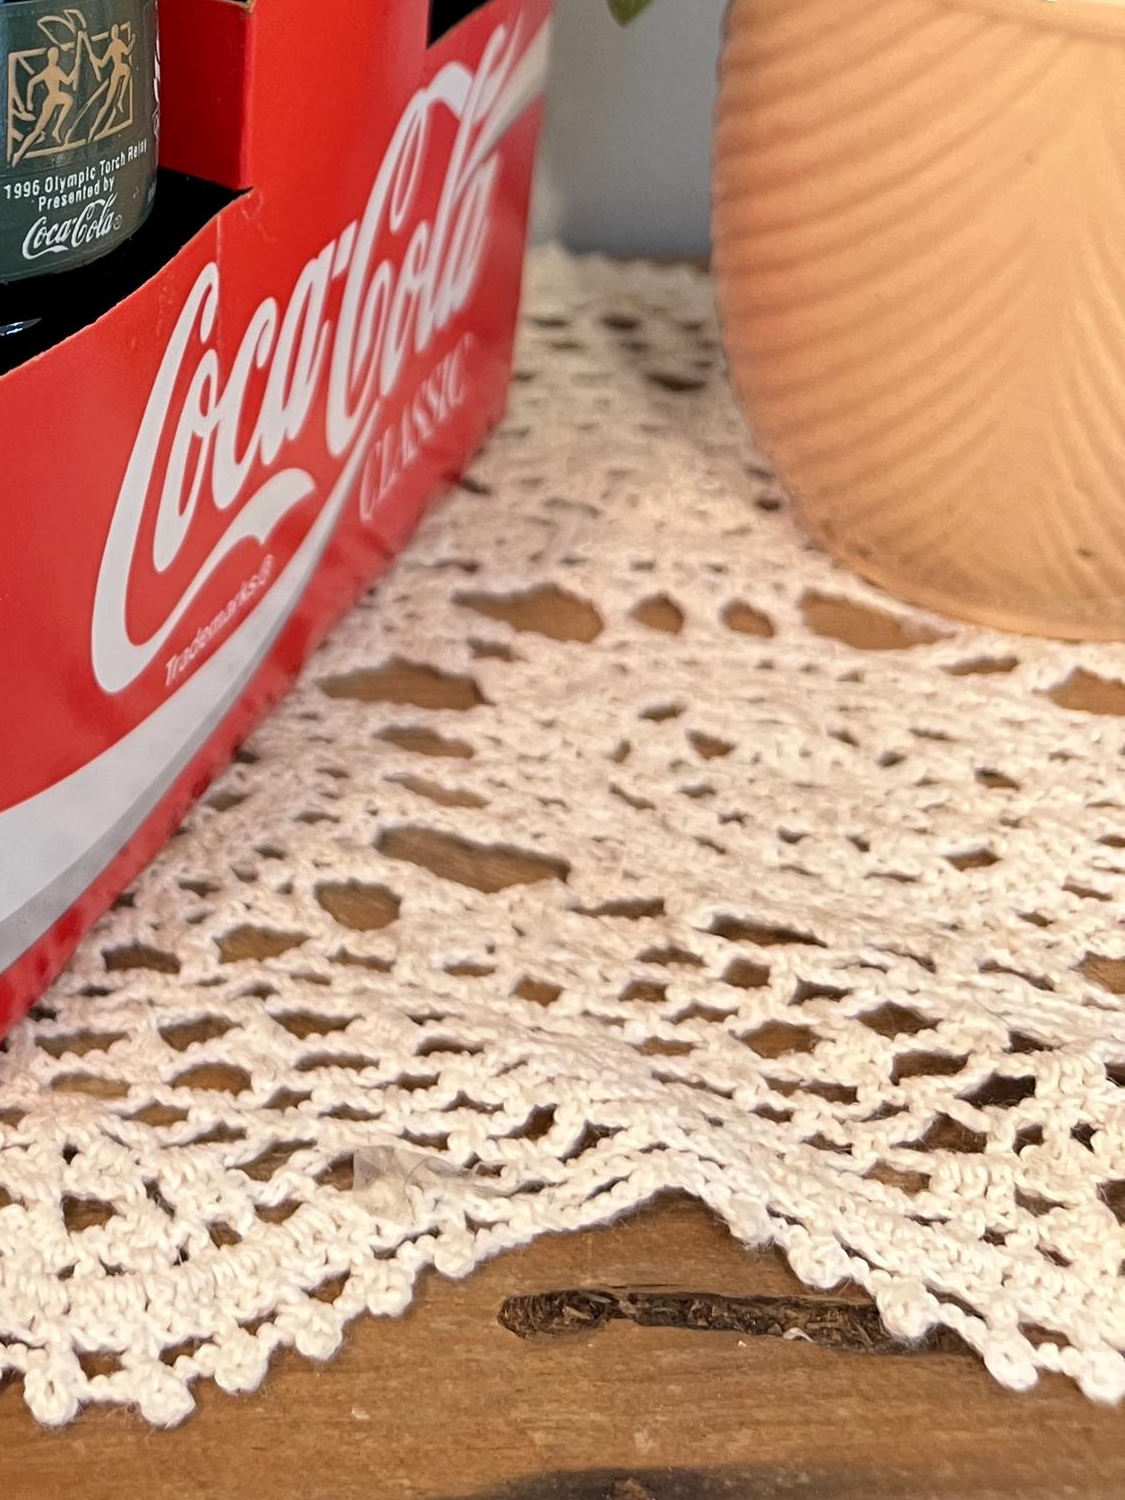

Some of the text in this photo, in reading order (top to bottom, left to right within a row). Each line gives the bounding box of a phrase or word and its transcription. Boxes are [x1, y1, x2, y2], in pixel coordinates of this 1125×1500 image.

[4, 182, 41, 200] 1996
[44, 166, 97, 195] Olympic
[99, 151, 127, 176] Torch
[38, 176, 116, 213] Presented by
[22, 192, 118, 261] Coca-Cola
